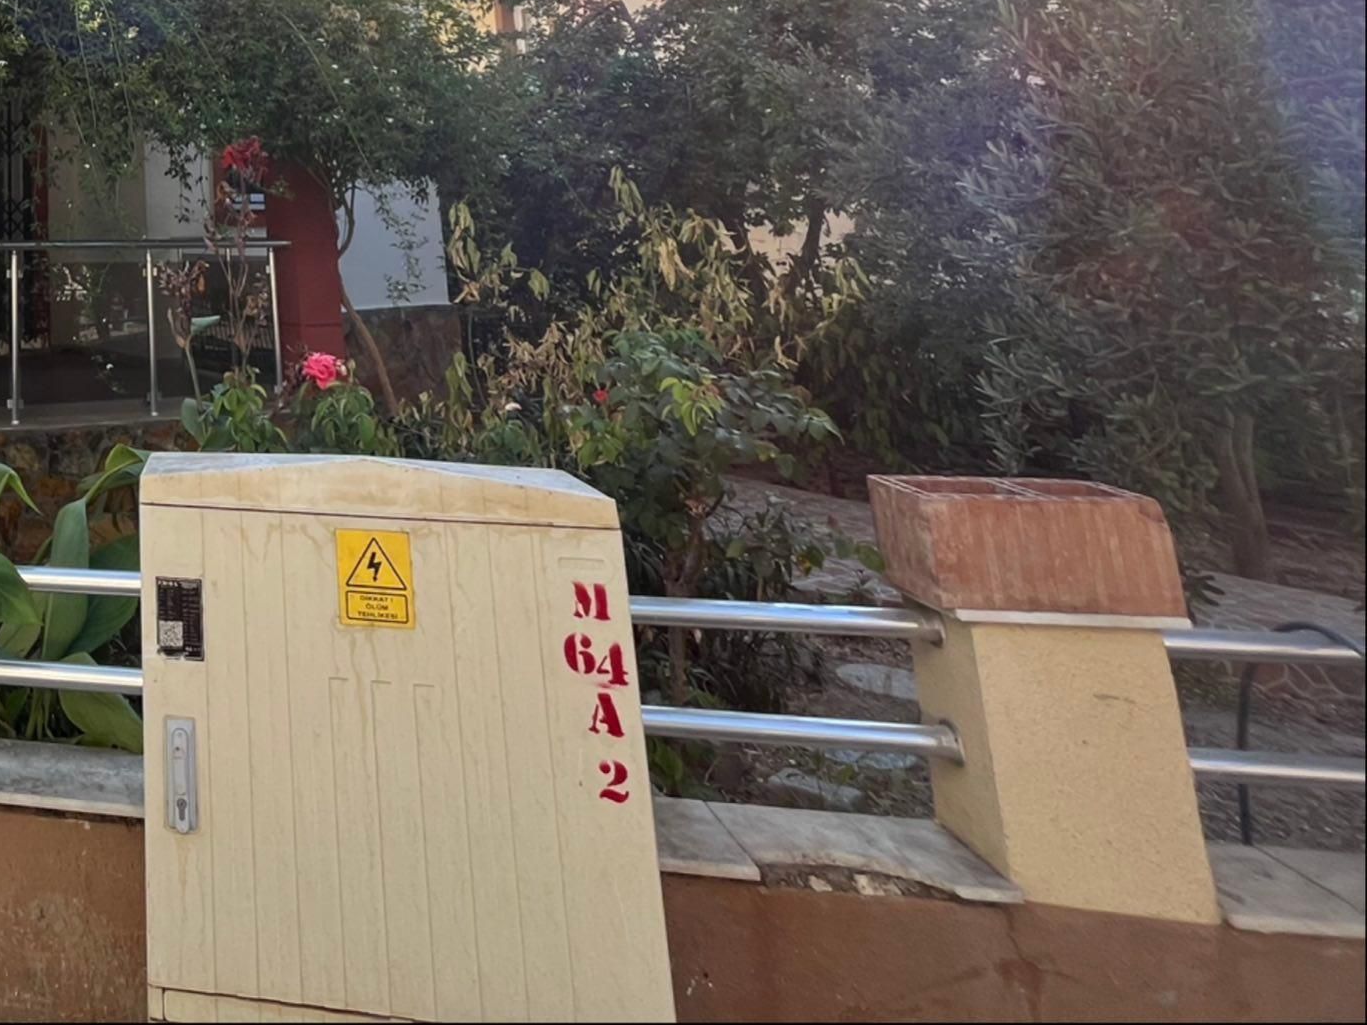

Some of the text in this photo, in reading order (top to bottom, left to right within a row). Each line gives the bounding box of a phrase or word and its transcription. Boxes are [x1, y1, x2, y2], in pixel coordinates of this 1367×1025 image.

[572, 581, 611, 621] M
[564, 632, 630, 687] 64
[588, 692, 626, 738] A
[599, 760, 630, 804] 2
